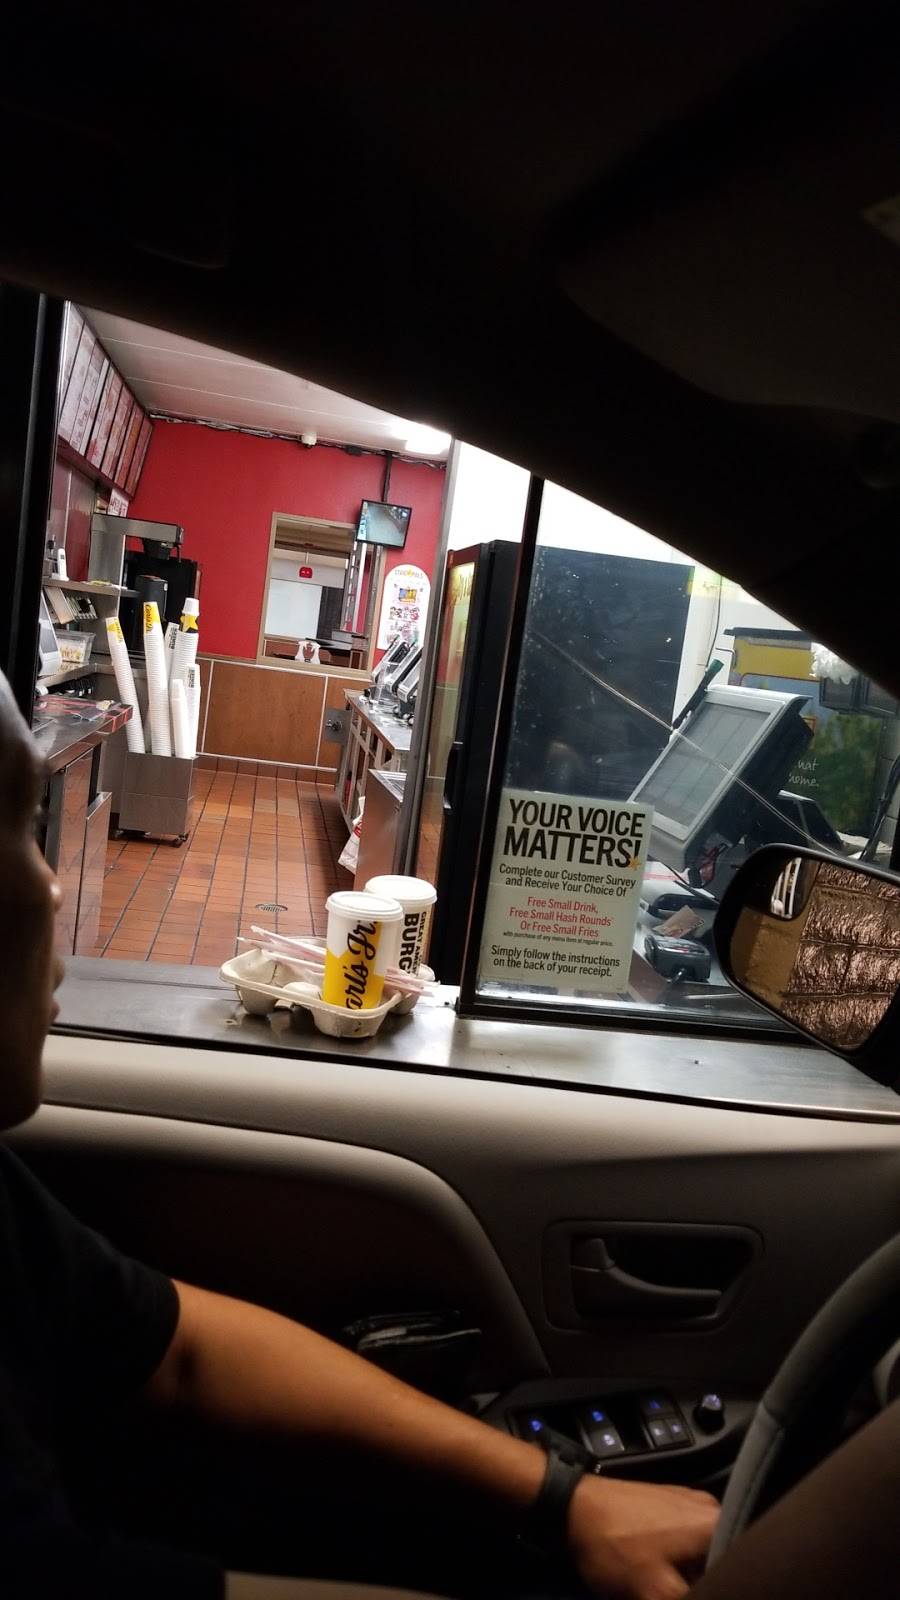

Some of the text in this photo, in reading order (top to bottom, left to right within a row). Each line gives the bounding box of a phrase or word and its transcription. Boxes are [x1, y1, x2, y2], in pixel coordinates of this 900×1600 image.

[509, 798, 646, 838] YOUR VOICE
[503, 825, 642, 870] MATTERS!
[499, 863, 636, 889] Complete our Customer Survey
[505, 876, 627, 897] and Receive Your Choice Of
[509, 906, 612, 927] Free Small Hash Rounds
[527, 896, 598, 913] Free Small Drink,
[416, 911, 427, 943] GREAT
[520, 920, 599, 938] Or Free Small Fries
[399, 912, 419, 974] BURG
[491, 944, 620, 967] Simply follow the instructions
[493, 957, 612, 978] on the back of your receipt.
[343, 961, 369, 1010] arl's
